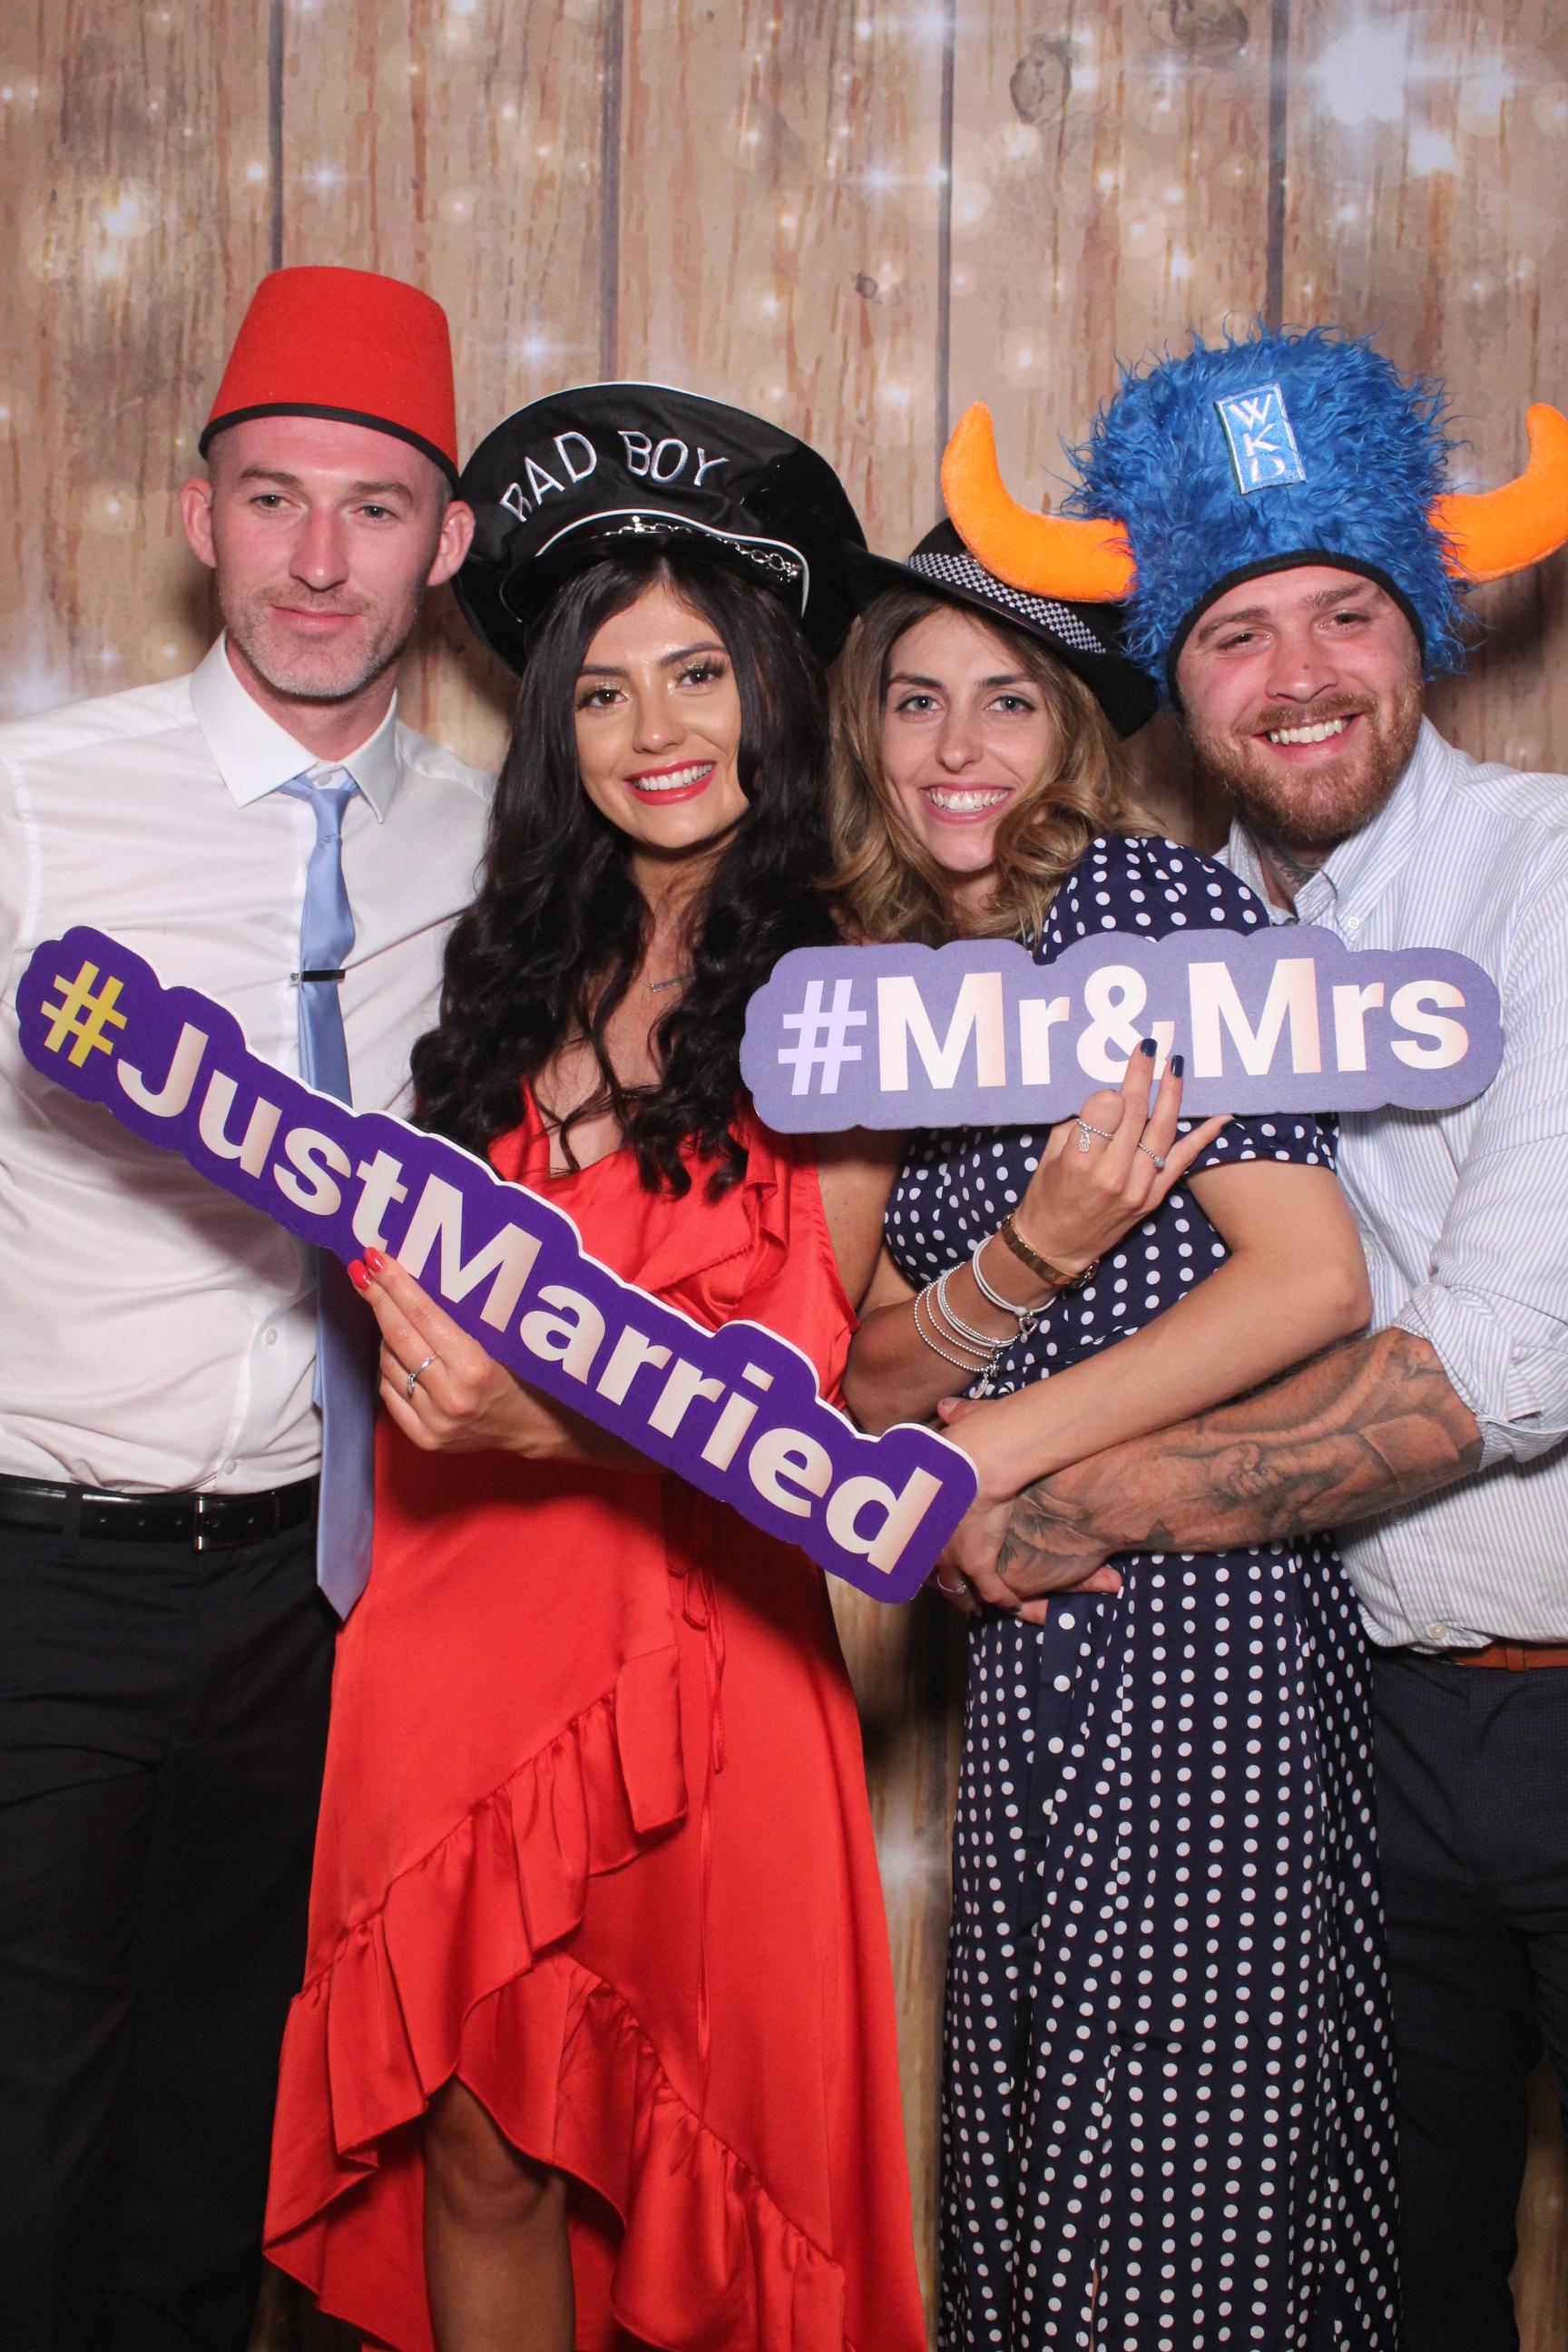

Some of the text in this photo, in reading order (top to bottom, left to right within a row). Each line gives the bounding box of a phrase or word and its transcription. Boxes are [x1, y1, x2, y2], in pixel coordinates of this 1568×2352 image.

[499, 430, 730, 523] BAD BOY
[778, 958, 1470, 1095] #Mr&Mrs
[41, 960, 943, 1574] #JustMarried
